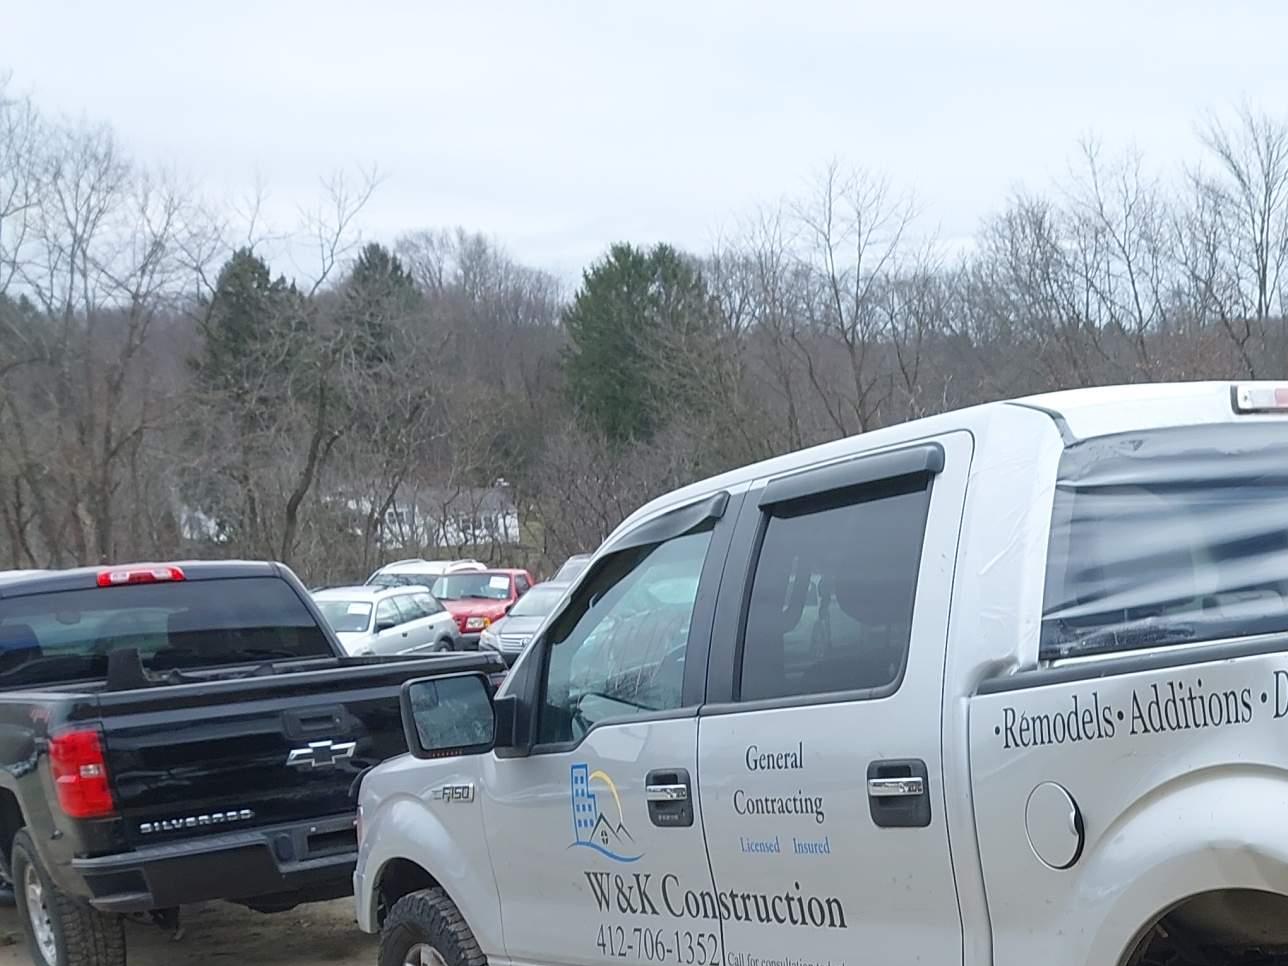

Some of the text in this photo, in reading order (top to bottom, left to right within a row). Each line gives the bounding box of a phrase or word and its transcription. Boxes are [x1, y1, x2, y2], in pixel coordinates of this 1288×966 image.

[746, 741, 803, 771] General
[140, 809, 255, 834] SILVERADO
[733, 789, 824, 824] Contracting
[740, 835, 831, 855] Licensed Insured
[585, 871, 848, 929] W&K Construction
